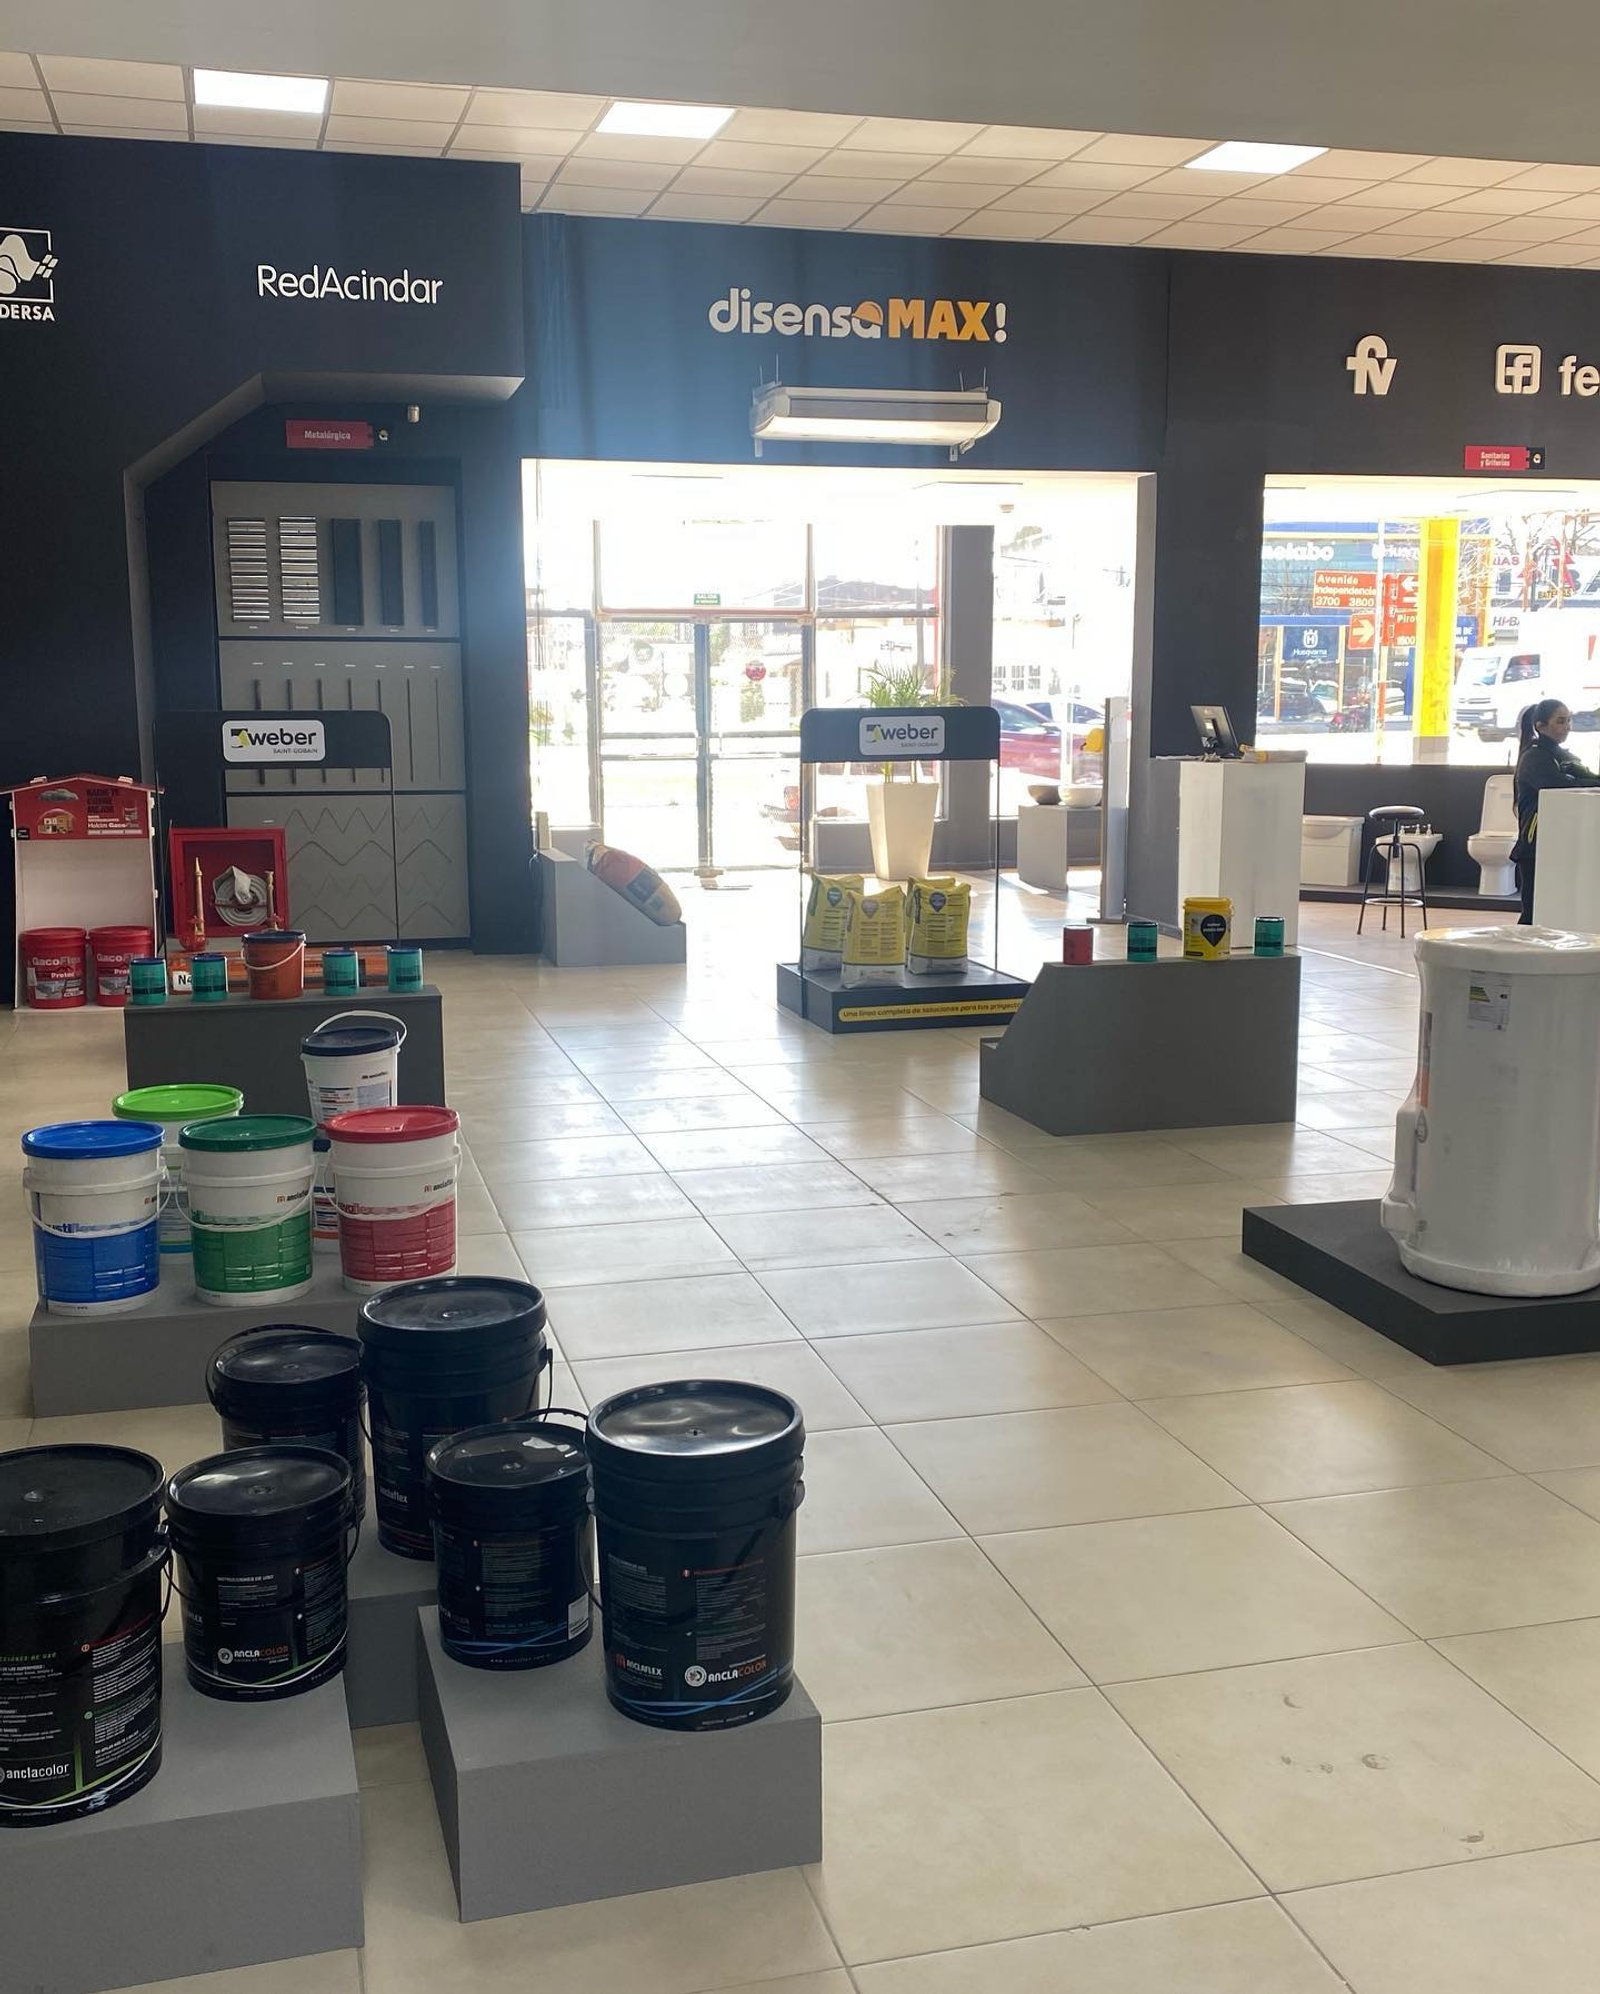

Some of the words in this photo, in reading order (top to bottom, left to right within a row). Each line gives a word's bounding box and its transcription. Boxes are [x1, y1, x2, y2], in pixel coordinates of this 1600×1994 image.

[257, 264, 443, 304] RedAcindar
[1558, 355, 1600, 396] fe
[1317, 575, 1359, 584] Avenida
[1315, 586, 1376, 595] Independencia
[1316, 597, 1340, 606] 3700
[1349, 598, 1374, 607] 3800
[1493, 616, 1520, 627] HI-B
[249, 728, 317, 746] weber
[881, 724, 938, 740] weber
[959, 1005, 977, 1013] para
[708, 1661, 767, 1683] ANCLACOLOR
[6, 1763, 70, 1779] anclacolor
